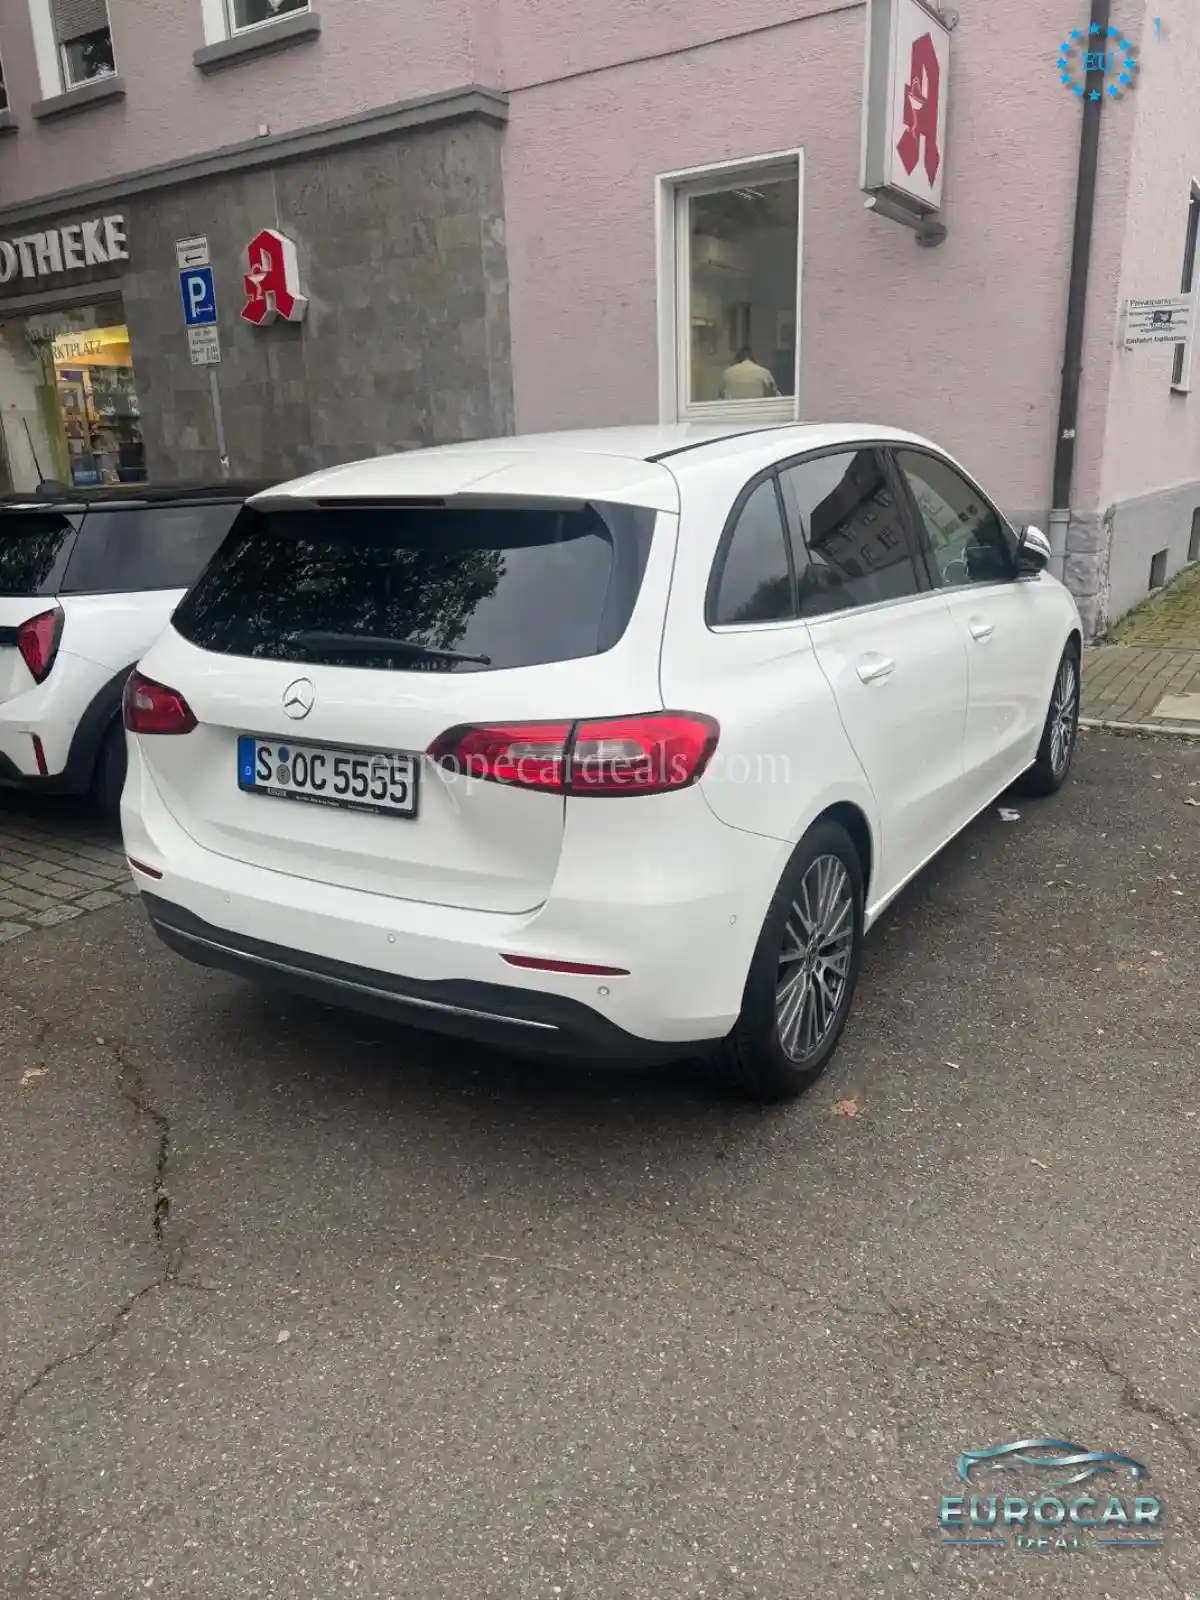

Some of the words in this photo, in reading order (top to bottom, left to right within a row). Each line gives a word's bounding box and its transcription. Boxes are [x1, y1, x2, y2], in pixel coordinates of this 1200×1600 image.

[187, 276, 207, 318] P
[256, 746, 273, 781] S
[291, 752, 327, 790] OC
[333, 757, 408, 804] 5555
